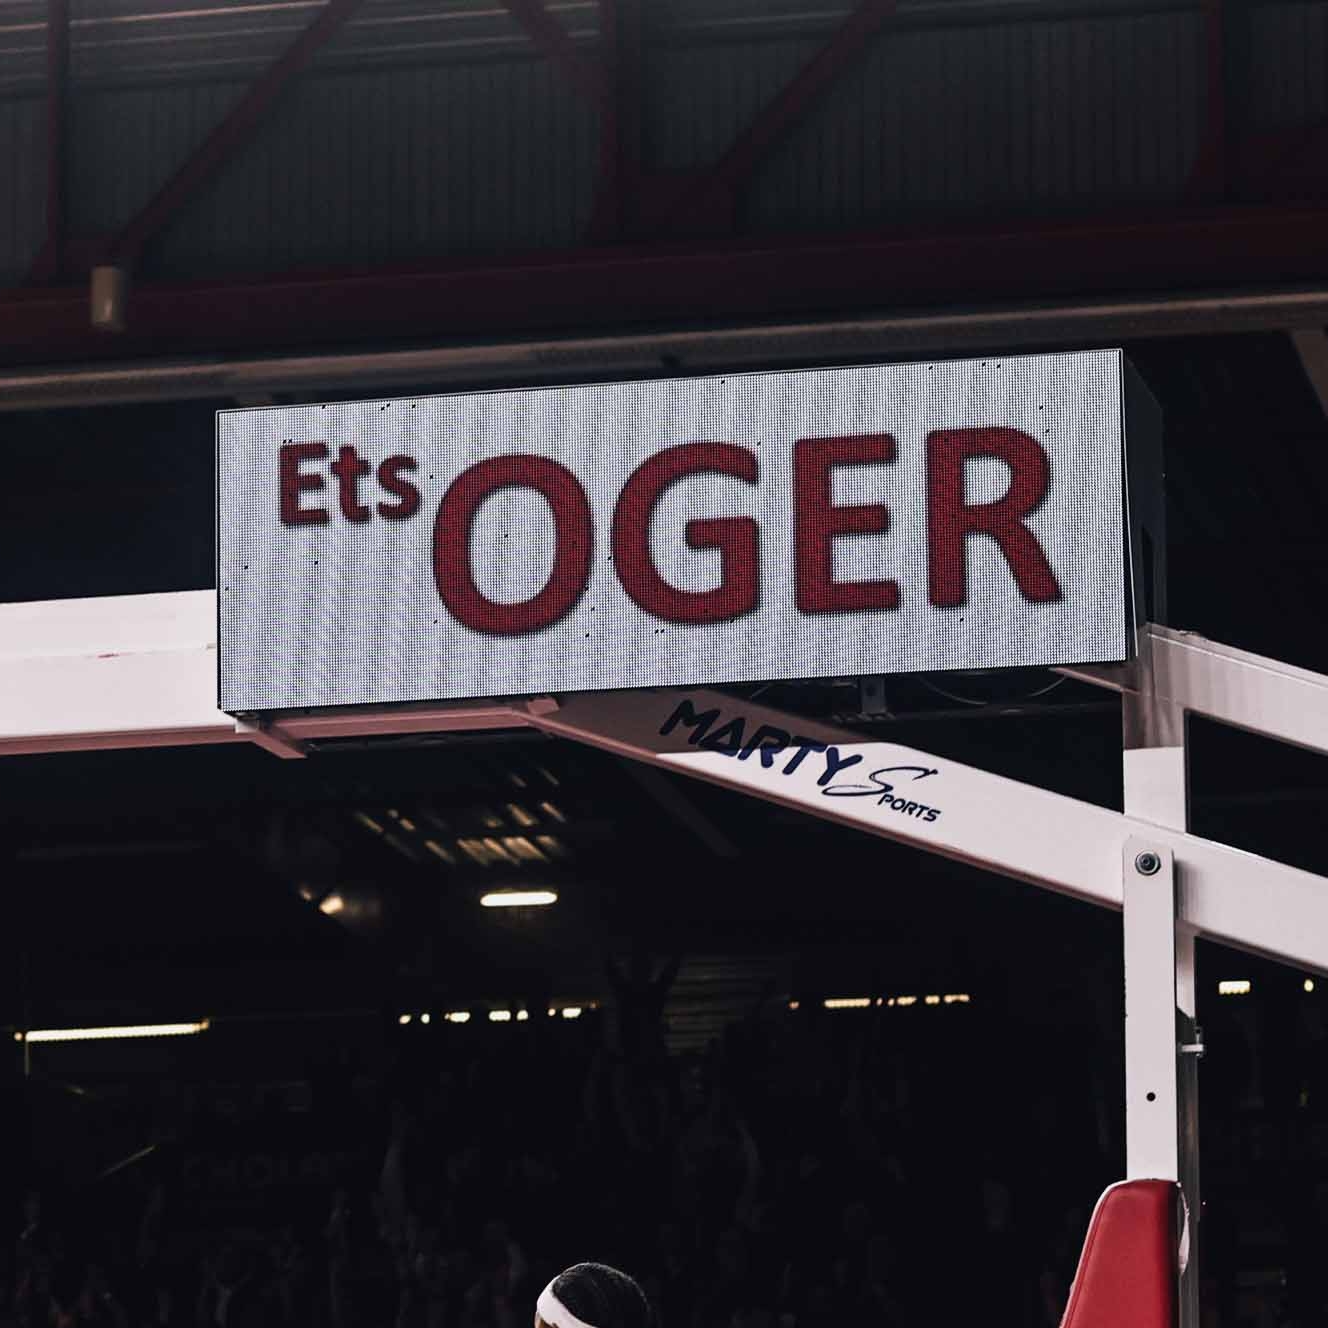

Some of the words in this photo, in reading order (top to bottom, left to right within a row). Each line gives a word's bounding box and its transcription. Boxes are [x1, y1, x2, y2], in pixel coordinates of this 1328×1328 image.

[279, 442, 420, 526] Ets
[433, 425, 1063, 637] OGER
[659, 699, 863, 786] MARTY
